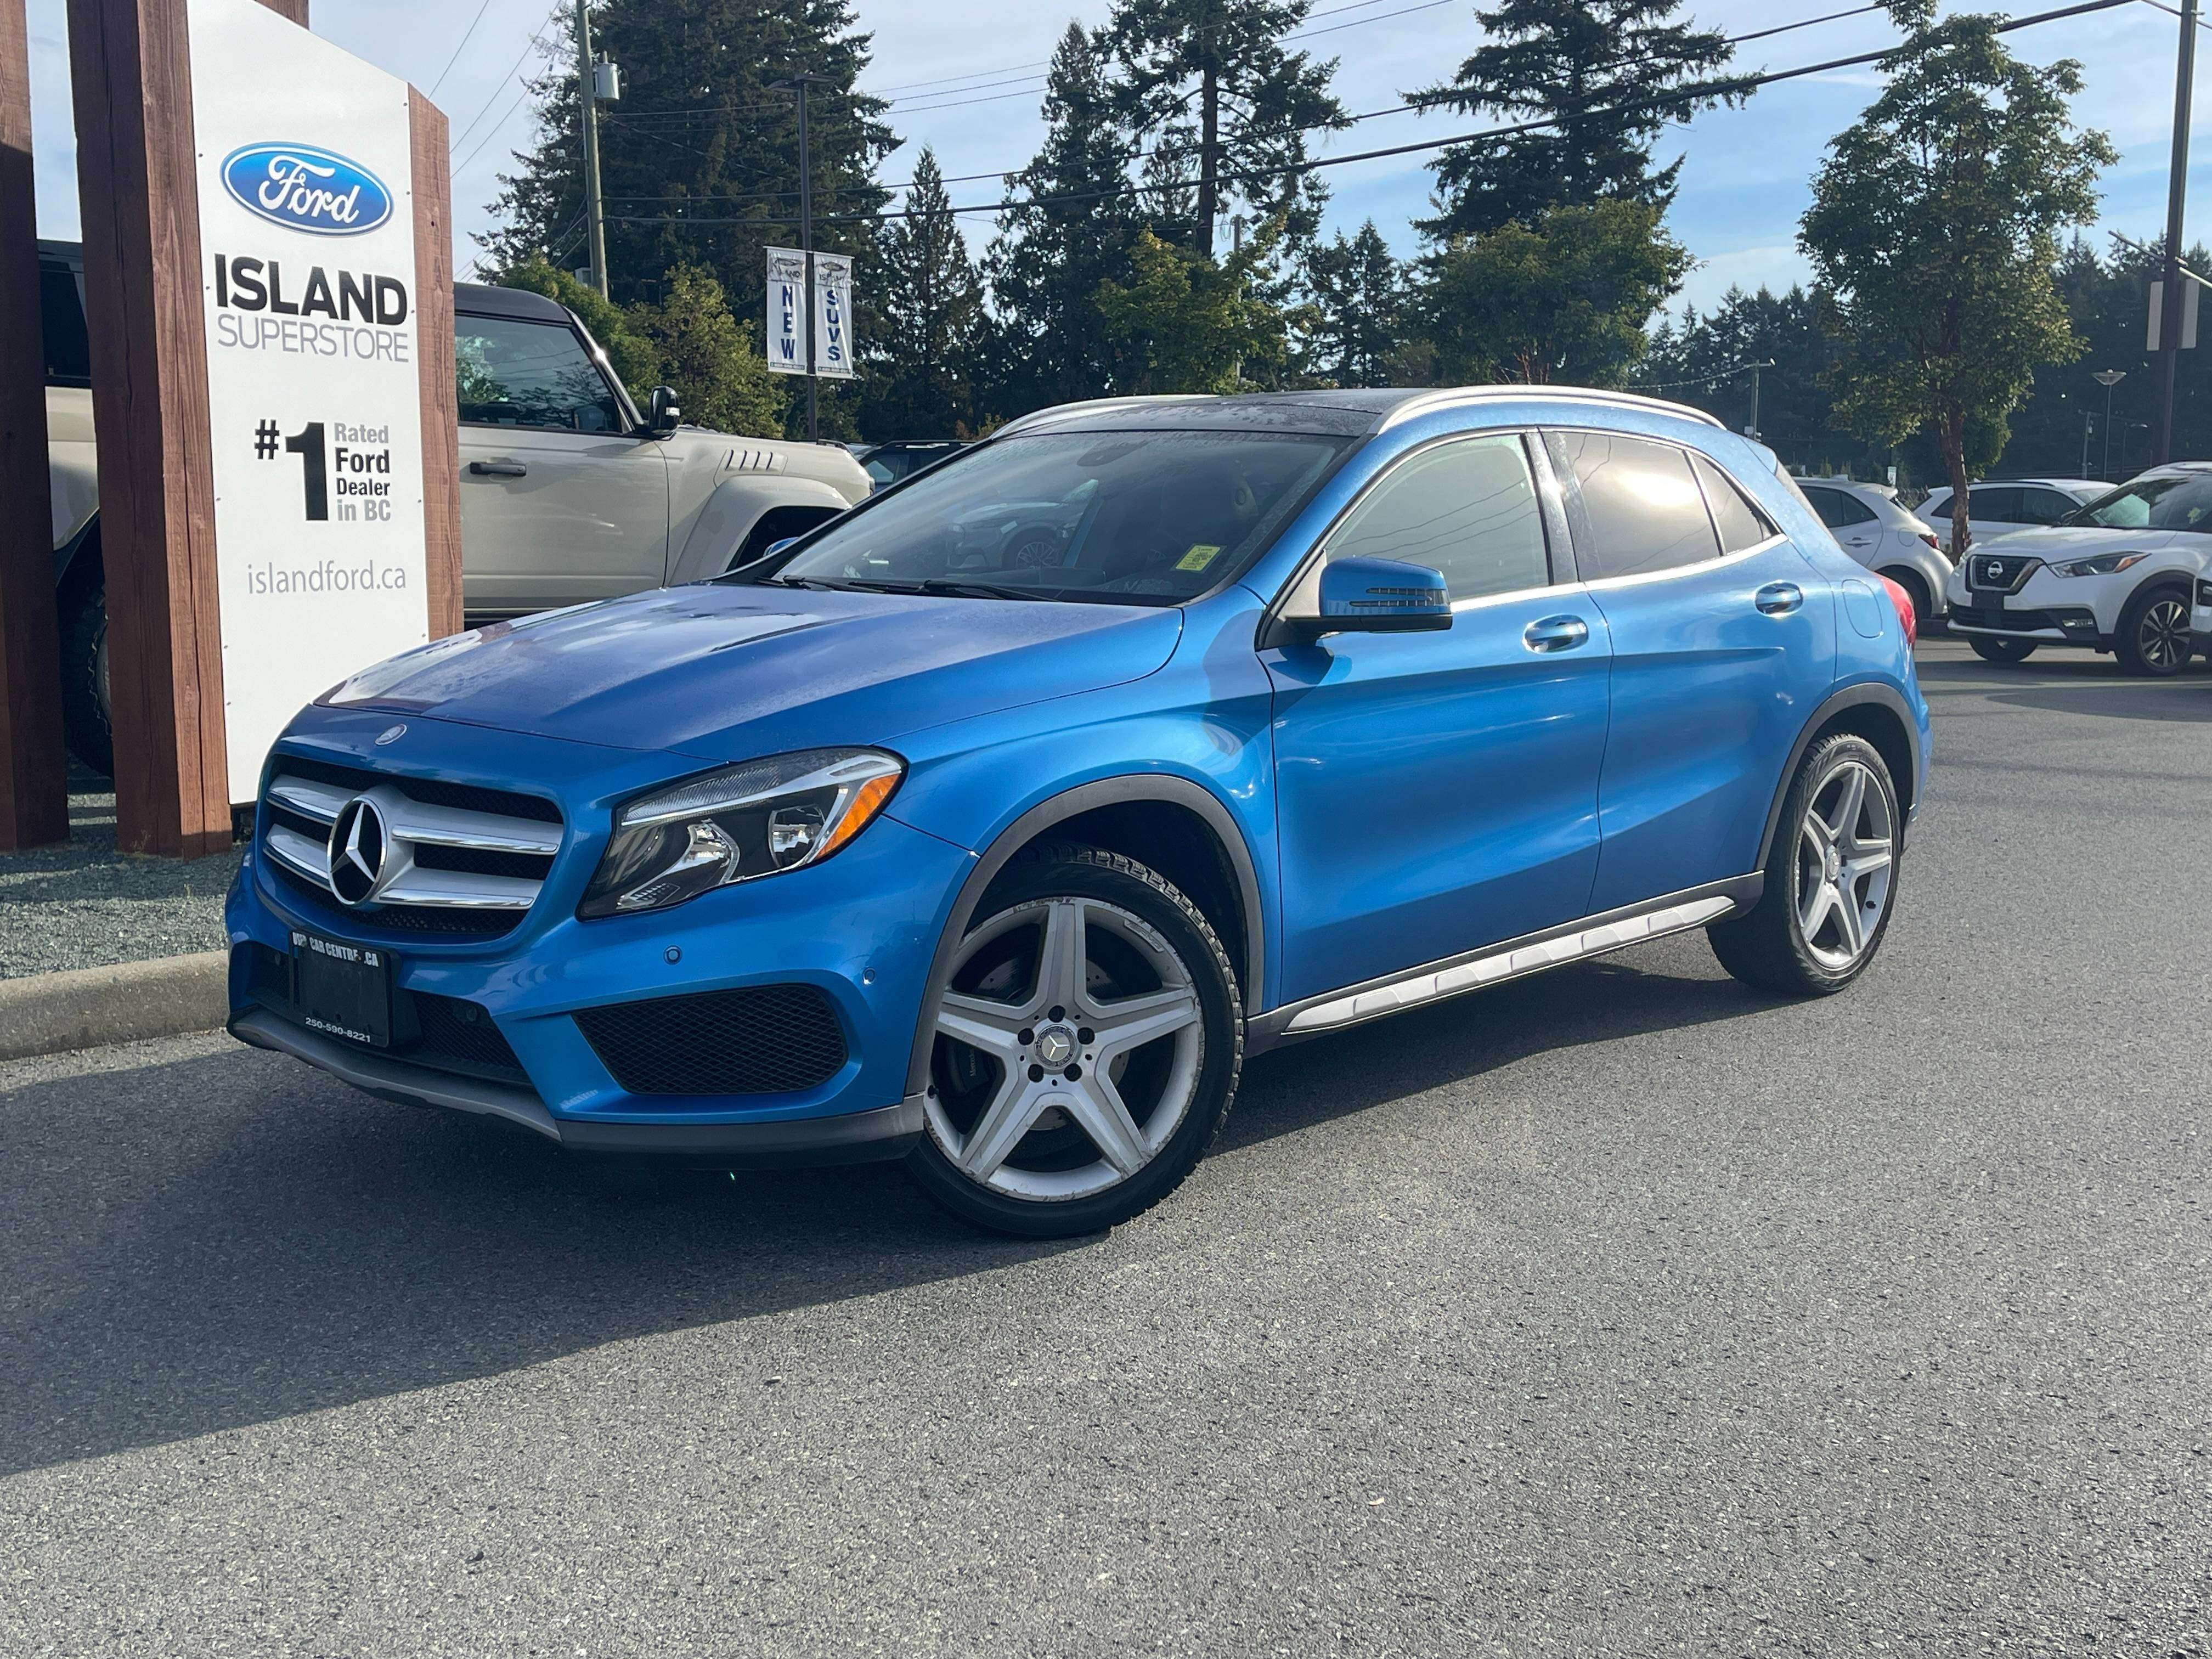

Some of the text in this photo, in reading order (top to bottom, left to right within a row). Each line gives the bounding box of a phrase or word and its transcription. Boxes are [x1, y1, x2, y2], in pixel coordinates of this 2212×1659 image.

[258, 155, 360, 224] Ford
[215, 253, 408, 326] ISLAND
[217, 313, 409, 363] SUPERSTORE
[781, 285, 795, 360] NEW
[826, 289, 841, 362] SUVS
[334, 422, 389, 444] Rated
[254, 419, 329, 521] #1
[335, 447, 391, 473] Ford
[336, 478, 391, 496] Dealer
[337, 499, 391, 521] in BC
[248, 560, 406, 594] islandford.ca
[309, 937, 326, 954] CAR
[325, 943, 359, 962] CENTRE
[305, 1017, 371, 1043] 250-590-8221
